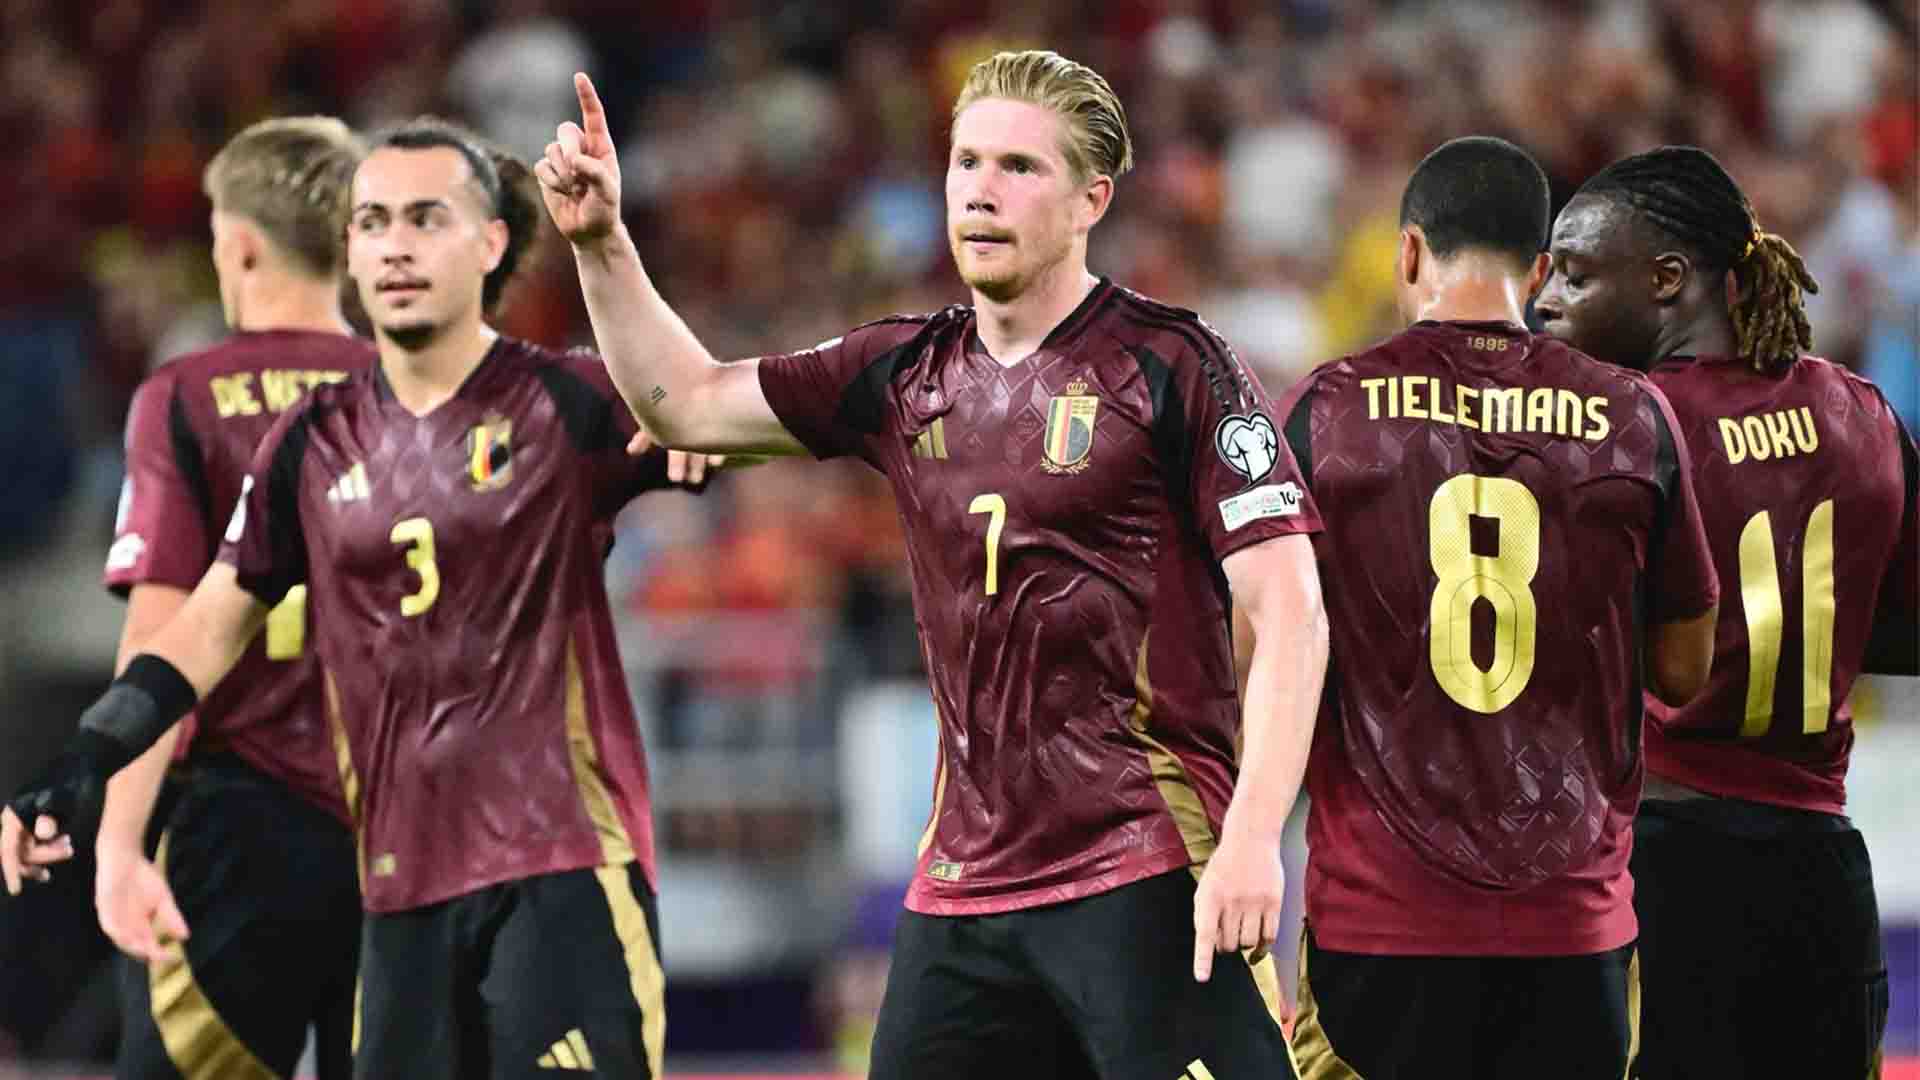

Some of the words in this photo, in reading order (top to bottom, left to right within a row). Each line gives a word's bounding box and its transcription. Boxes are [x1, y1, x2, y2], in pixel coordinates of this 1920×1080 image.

[209, 372, 262, 418] DE
[1360, 376, 1610, 441] TIELEMANS
[1718, 406, 1819, 465] DOKU
[389, 517, 441, 617] 3
[968, 493, 1007, 596] 7
[1429, 473, 1541, 714] 8
[1738, 499, 1836, 737] 11
